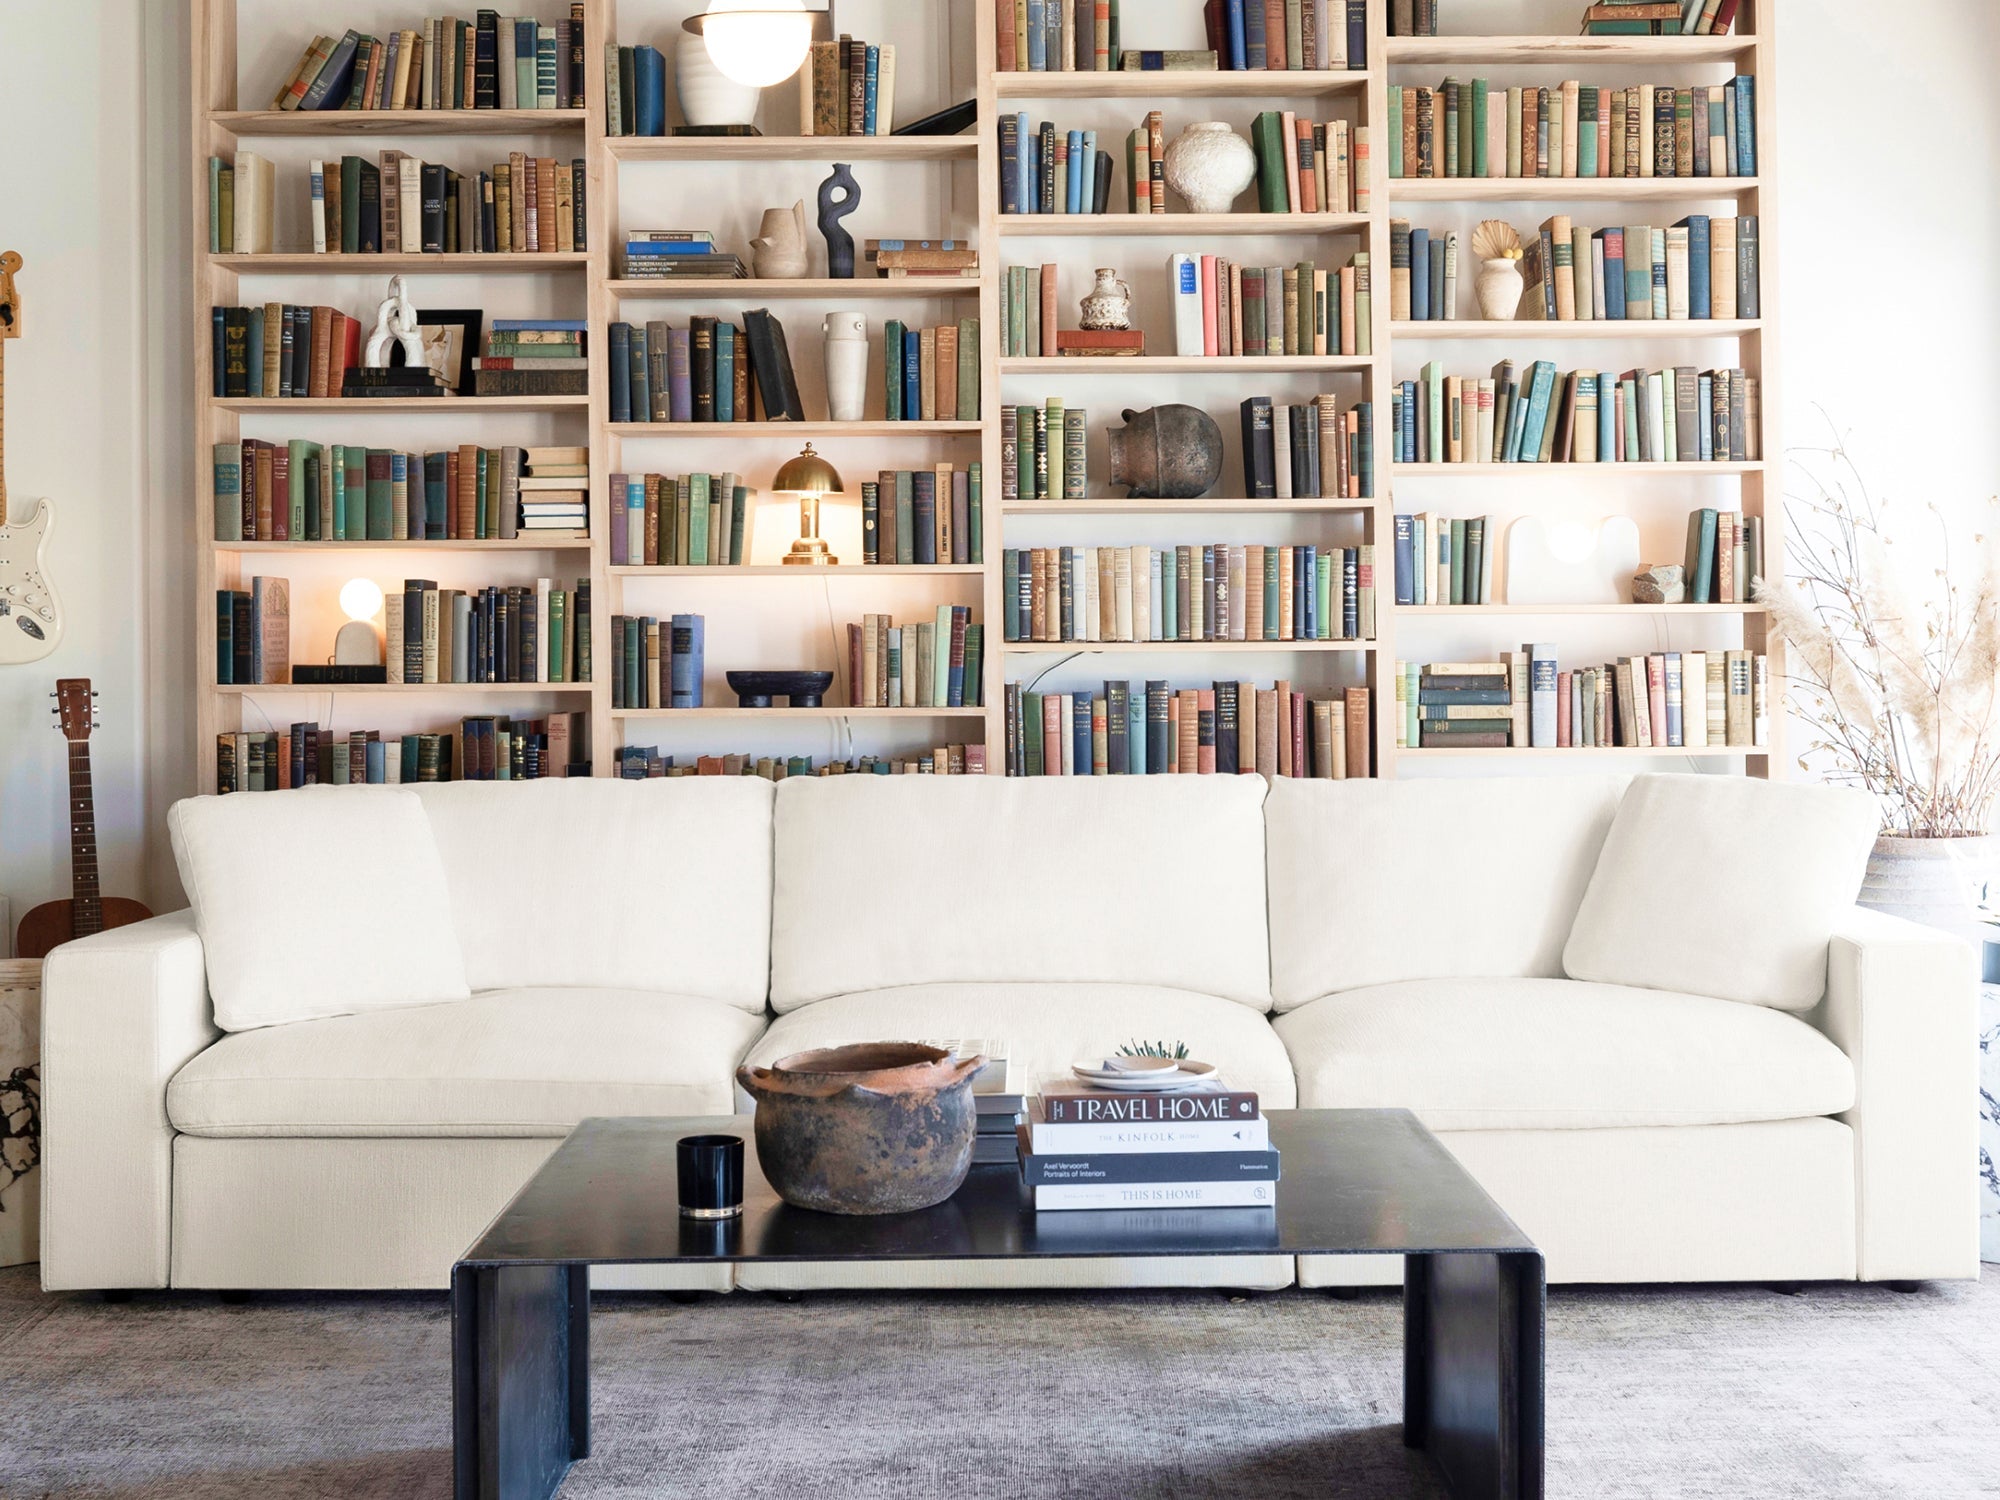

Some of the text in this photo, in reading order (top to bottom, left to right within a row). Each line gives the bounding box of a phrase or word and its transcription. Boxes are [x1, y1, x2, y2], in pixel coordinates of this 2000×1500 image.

[1047, 156, 1053, 167] OF
[1073, 1098, 1153, 1121] TRAVEL
[1159, 1097, 1230, 1120] HOME
[1117, 1131, 1176, 1143] KINFOLK
[1043, 1162, 1090, 1170] Axel Vervoordt
[1043, 1170, 1071, 1178] Portraits
[1121, 1189, 1203, 1201] THIS IS HOME
